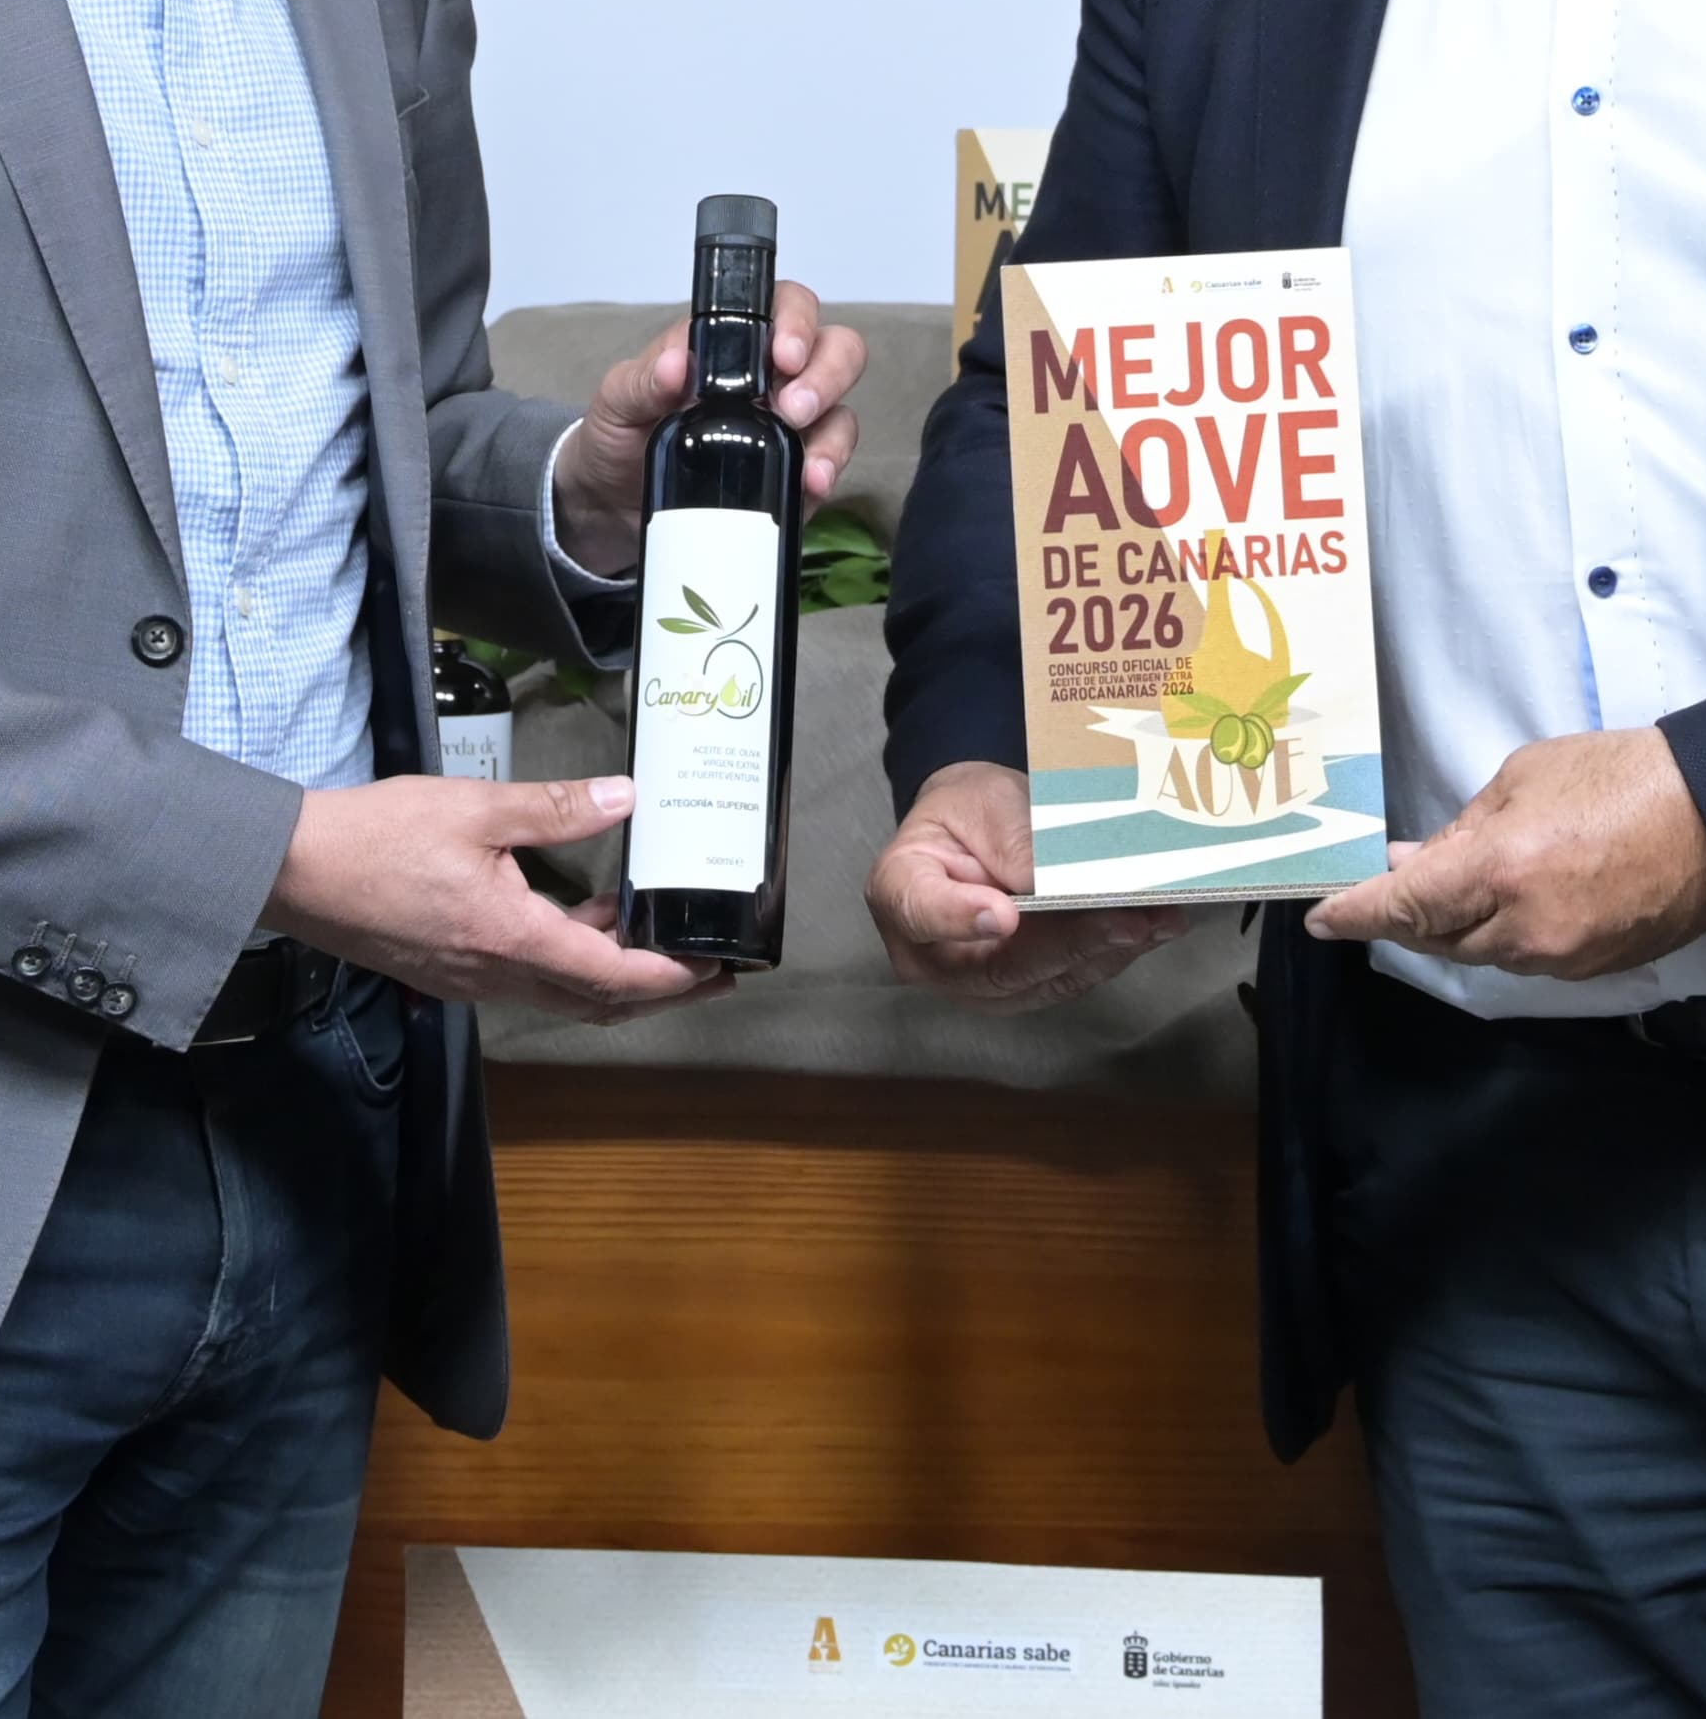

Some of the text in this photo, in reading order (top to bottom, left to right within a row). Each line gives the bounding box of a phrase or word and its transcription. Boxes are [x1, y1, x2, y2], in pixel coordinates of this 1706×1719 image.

[1030, 315, 1334, 415] MEJOR
[1042, 409, 1344, 535] AOVE
[1043, 532, 1347, 589] DE CANARIAS
[1047, 592, 1183, 654] 2026
[1049, 657, 1192, 677] CONCURSO OFICIAL DE
[1050, 671, 1193, 687] ACEITE DE OLIVA VIRGEN EXTRA
[1051, 681, 1194, 702] AGROCANARIAS 2026
[693, 746, 761, 758] ACEITE DE OLIVA
[703, 759, 760, 770] VIRGEN EXTRA
[678, 770, 760, 783] DE FUERTEVENTURA
[1157, 738, 1308, 819] AOVE
[660, 797, 759, 812] CATEGORÍA SUPERIOR
[923, 1639, 1071, 1662] Canarias sabe
[1152, 1651, 1212, 1664] Gobierno
[1152, 1665, 1225, 1677] de Canarias
